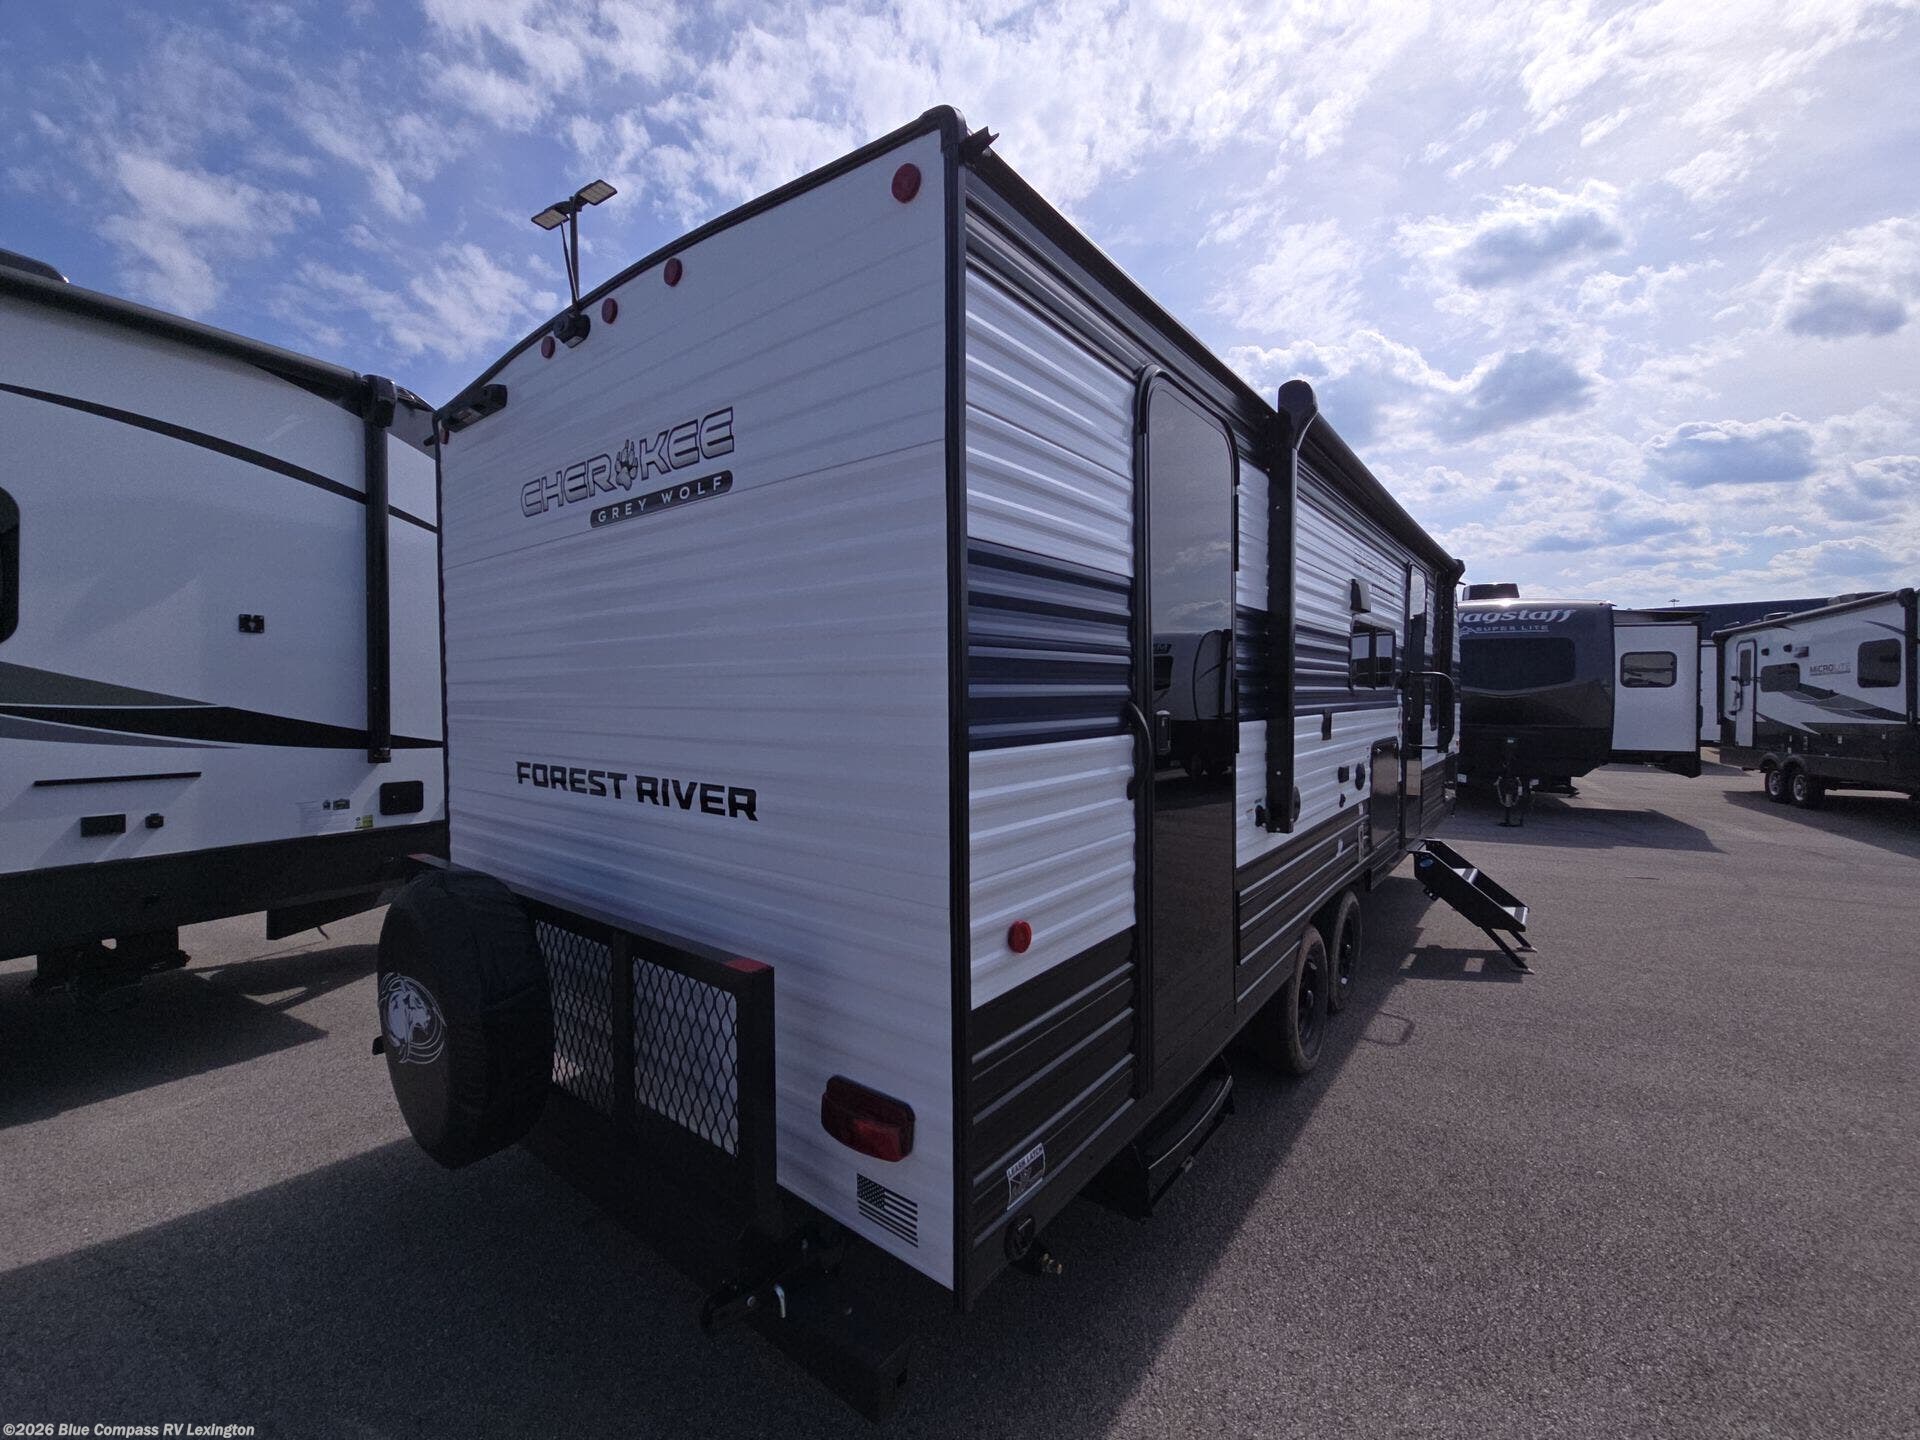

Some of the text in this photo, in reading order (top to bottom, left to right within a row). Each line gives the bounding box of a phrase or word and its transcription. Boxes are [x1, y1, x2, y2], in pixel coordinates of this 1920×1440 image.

[598, 476, 723, 523] GREY WOLF
[516, 761, 758, 821] FOREST RIVER
